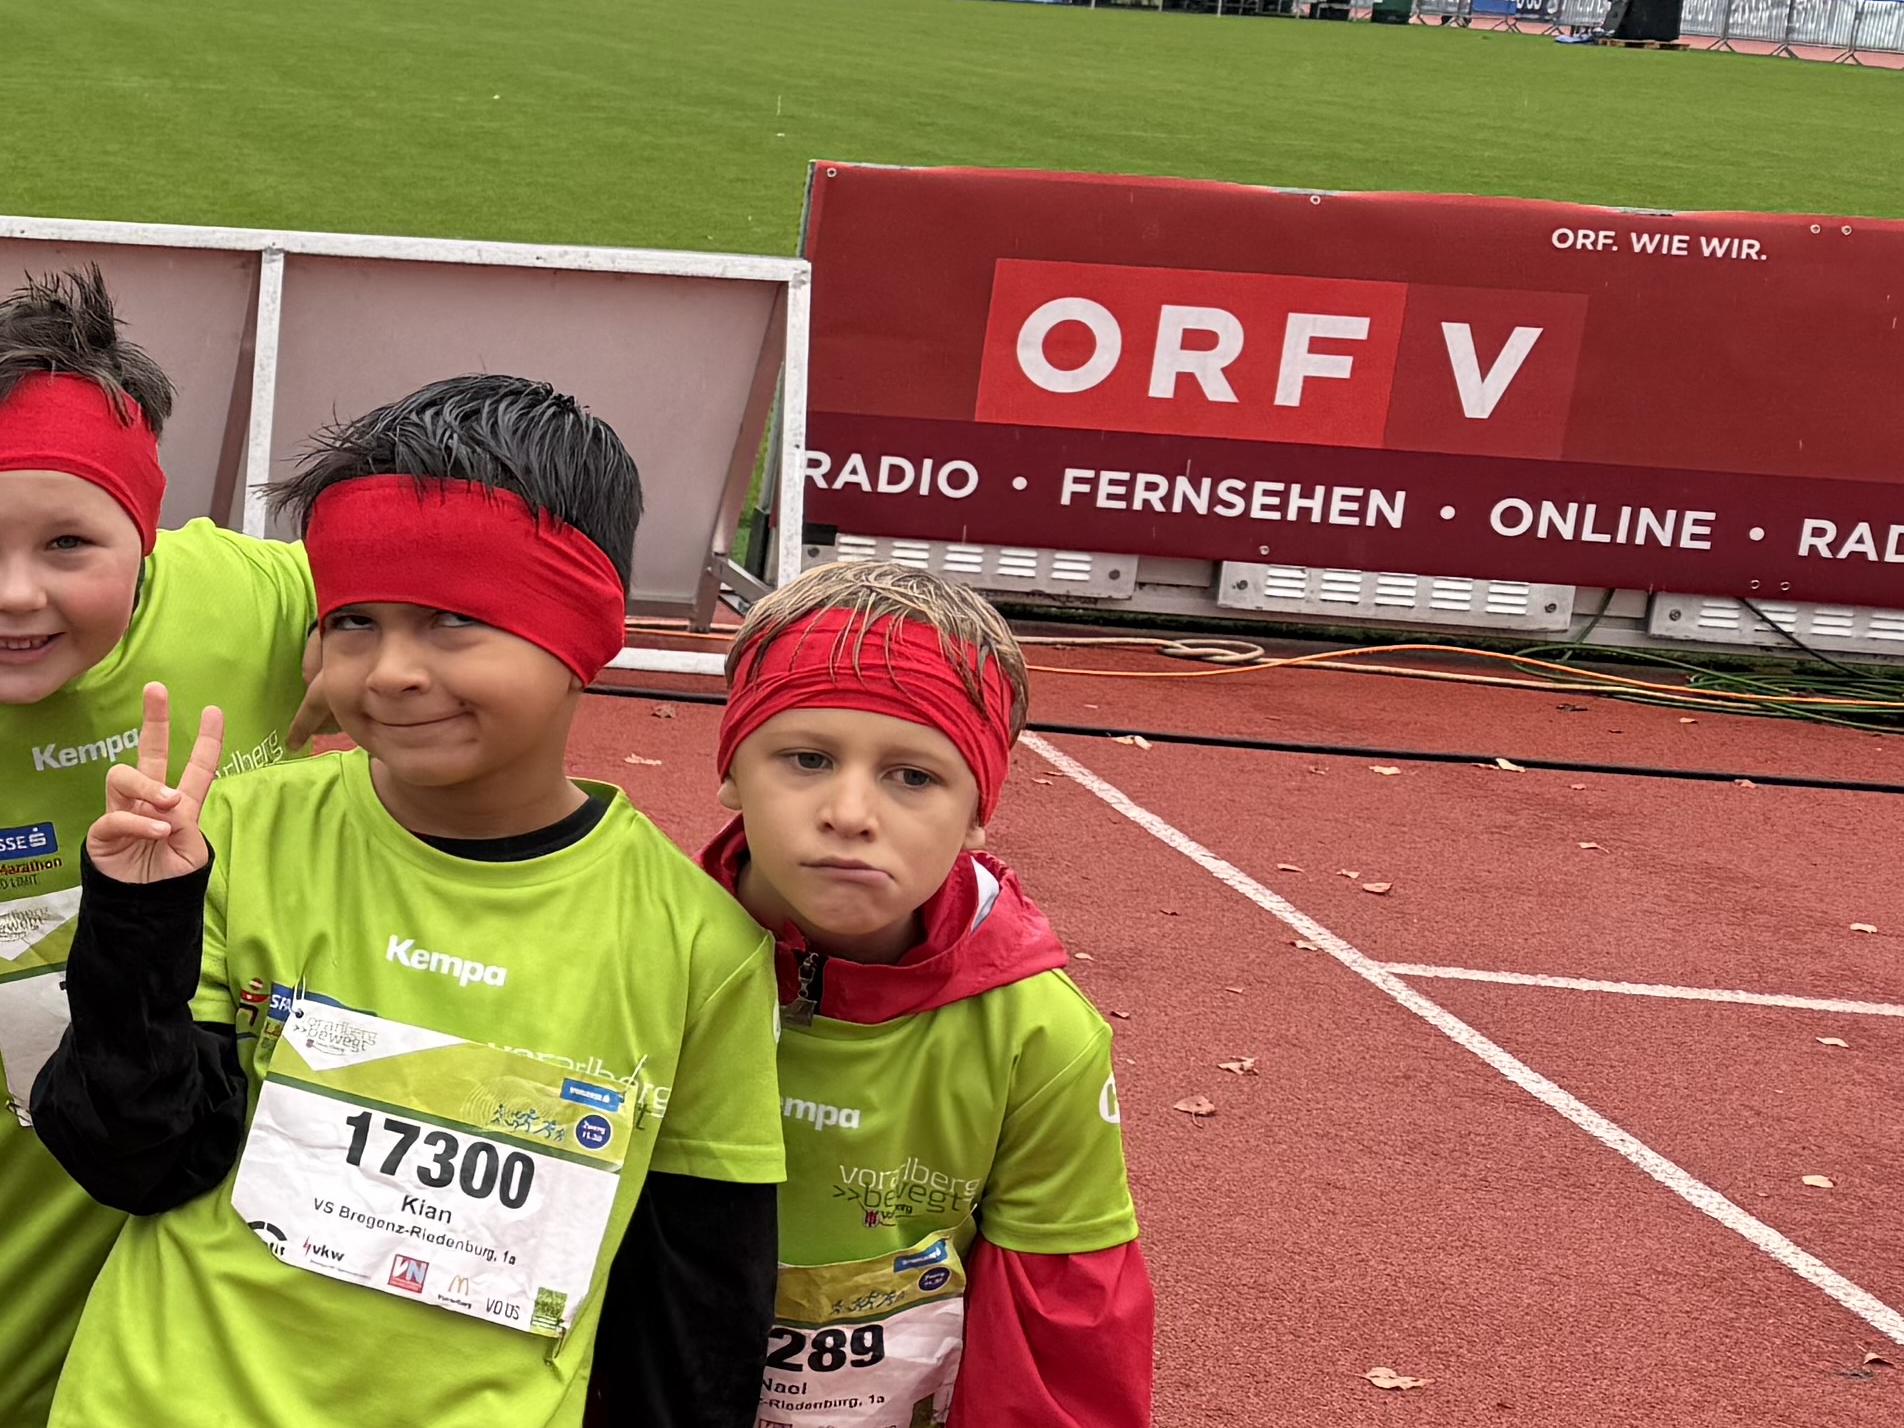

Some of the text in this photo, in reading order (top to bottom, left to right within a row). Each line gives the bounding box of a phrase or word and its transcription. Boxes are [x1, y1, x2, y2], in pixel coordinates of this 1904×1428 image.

[1551, 228, 1768, 261] ORF. WIE WIR.
[1015, 295, 1544, 420] ORF V
[803, 449, 980, 500] RADIO
[1060, 467, 1408, 530] FERNSEHEN
[1490, 497, 1717, 551] ONLINE
[31, 728, 138, 771] Kempa
[385, 934, 507, 989] Kempa
[345, 1110, 536, 1210] 17300
[314, 1197, 334, 1214] VS
[502, 1248, 517, 1265] 1a
[401, 1195, 452, 1225] Kian
[313, 1244, 345, 1263] vkw
[765, 1324, 886, 1372] 289
[868, 1394, 886, 1405] 1a
